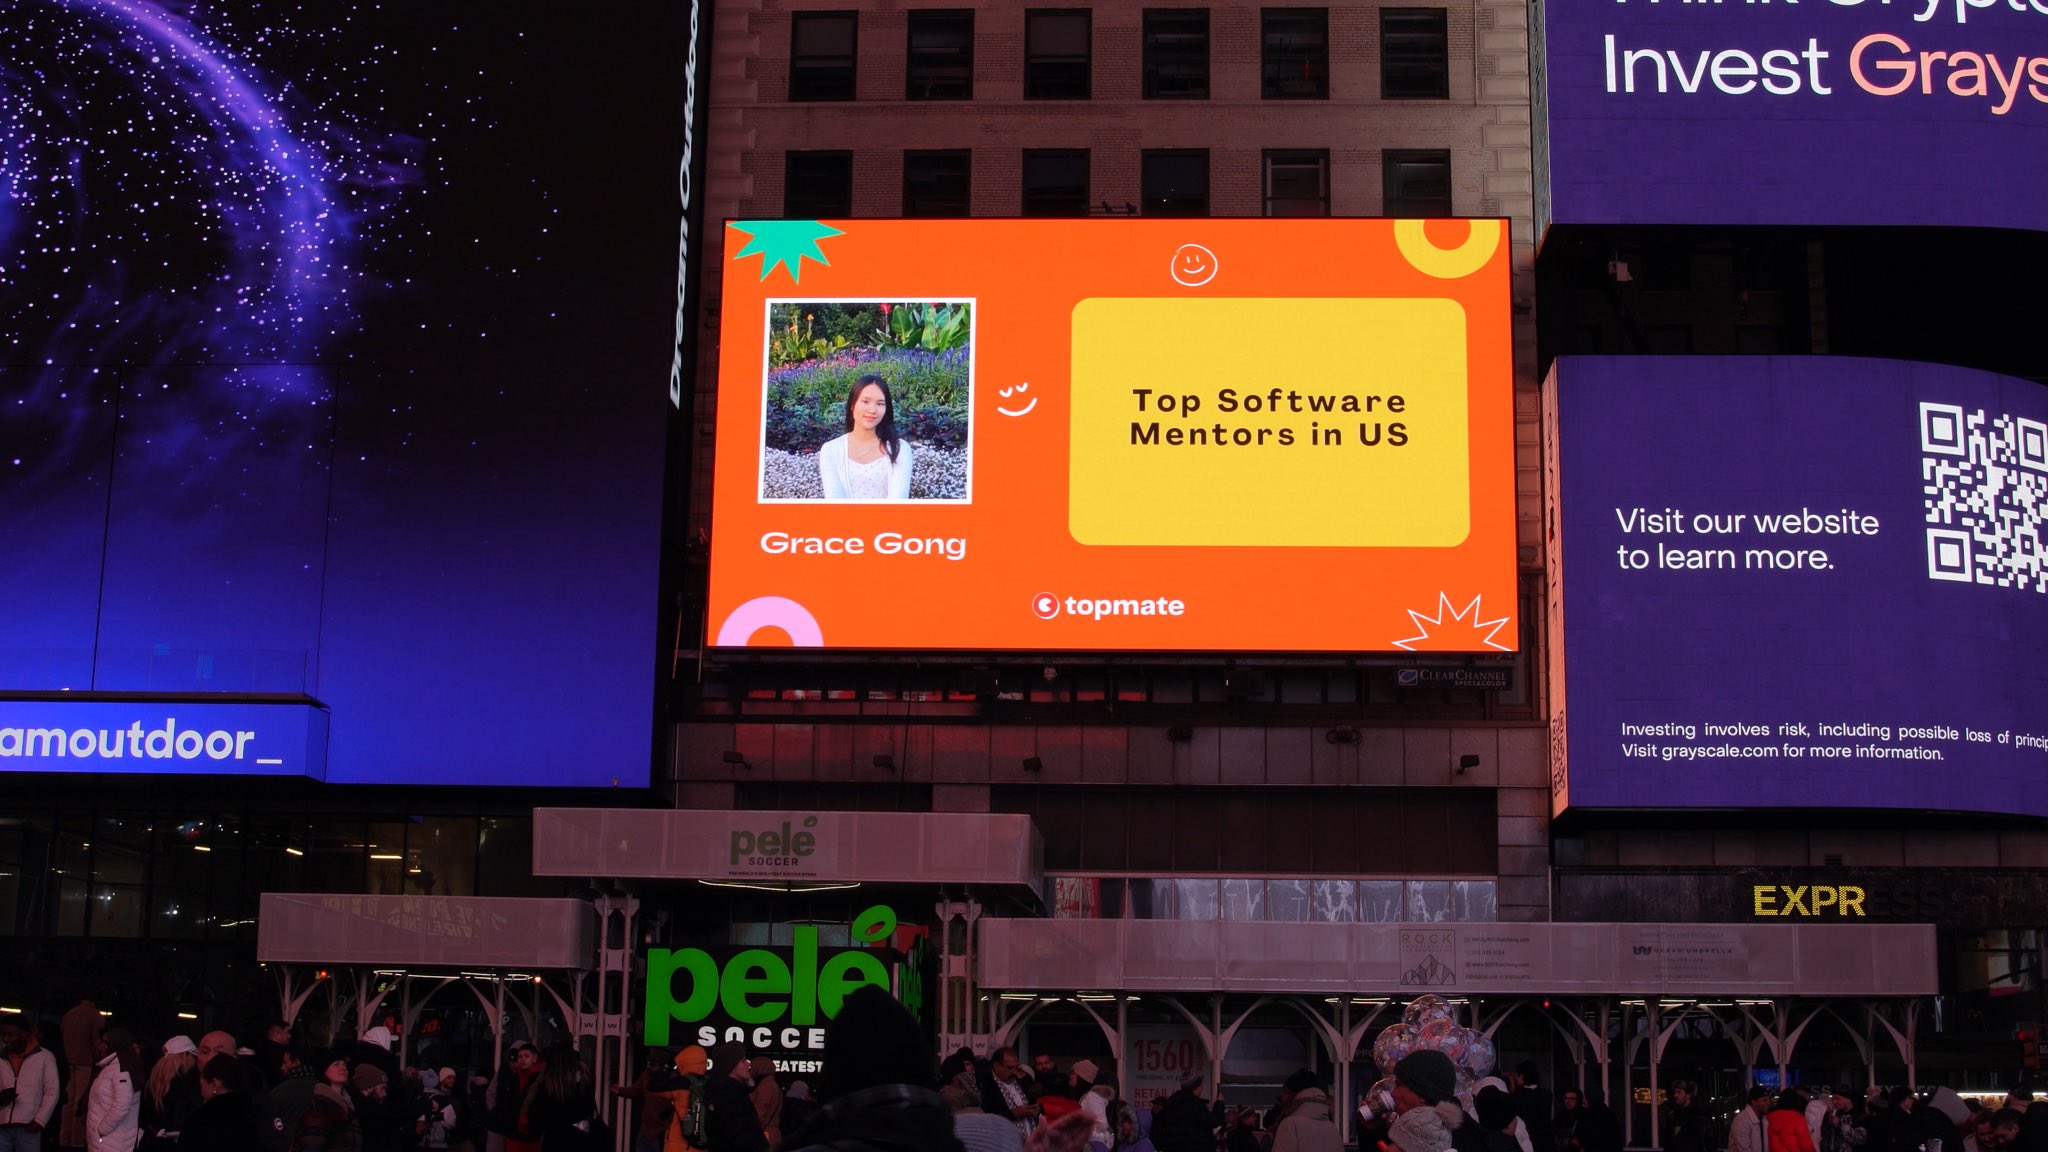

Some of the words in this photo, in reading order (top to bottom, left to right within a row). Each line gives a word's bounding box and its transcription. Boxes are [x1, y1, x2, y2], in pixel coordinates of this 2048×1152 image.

[1604, 34, 1832, 95] Invest
[670, 216, 689, 410] Dream
[1132, 388, 1201, 418] Top
[1217, 387, 1406, 414] Software
[1130, 422, 1295, 446] Mentors
[1311, 422, 1342, 446] in
[1359, 422, 1409, 447] US
[1615, 507, 1685, 534] Visit
[1693, 513, 1747, 534] our
[1753, 507, 1880, 536] website
[760, 531, 865, 555] Grace
[873, 531, 967, 561] Gong
[1616, 544, 1650, 570] to
[1658, 542, 1736, 570] learn
[1745, 549, 1834, 570] more.
[1064, 596, 1185, 621] topmate
[1621, 722, 1696, 740] Investing
[1704, 721, 1770, 738] involves
[1778, 722, 1811, 739] risk,
[1818, 722, 1891, 741] including
[1898, 725, 1960, 742] possible
[1965, 727, 1992, 743] loss
[1997, 730, 2010, 744] of
[1621, 743, 1658, 758] Visit
[1661, 743, 1779, 761] grayscale.com
[1782, 742, 1806, 758] for
[1809, 746, 1852, 758] more
[1855, 743, 1944, 761] information.
[730, 816, 818, 865] pelé
[748, 857, 799, 867] SOCCER
[1401, 934, 1452, 944] ROCK
[644, 905, 897, 1047] pelé
[697, 1025, 826, 1049] SOCCE
[772, 1059, 824, 1073] EATEST
[1134, 1039, 1194, 1072] 1560
